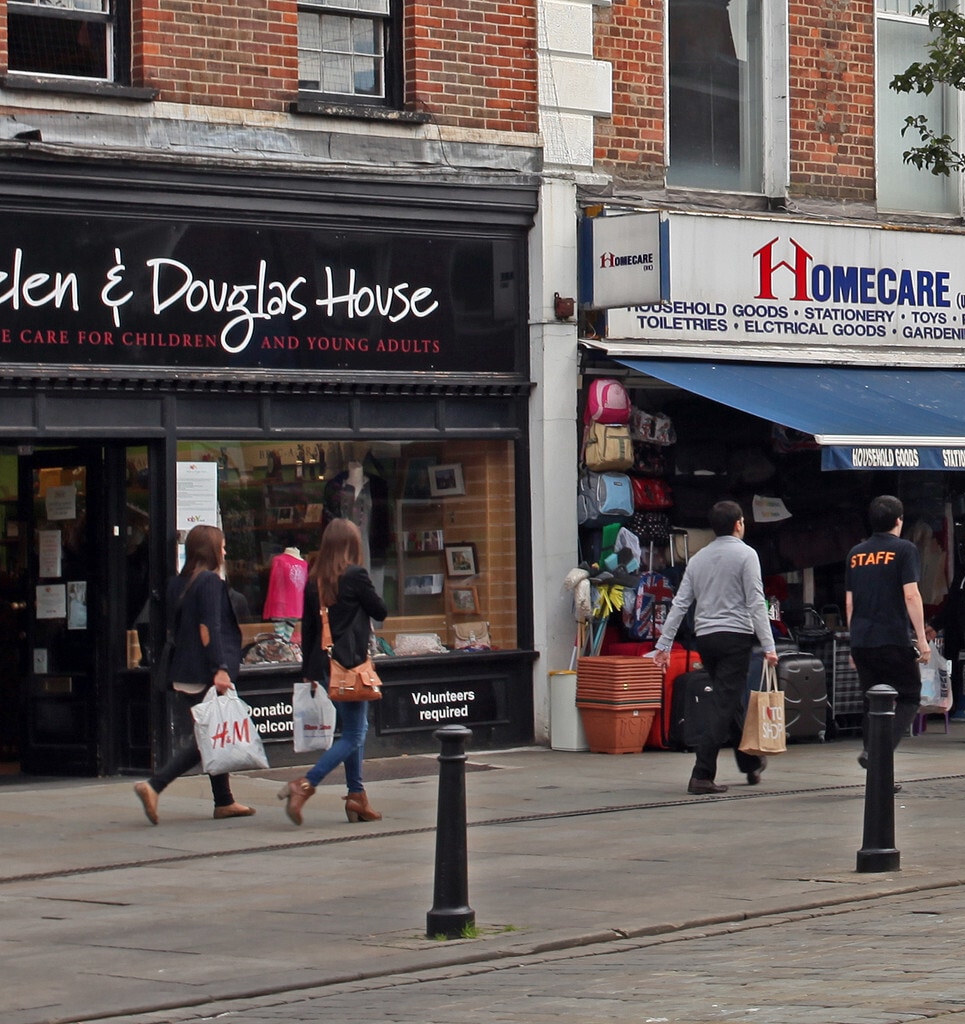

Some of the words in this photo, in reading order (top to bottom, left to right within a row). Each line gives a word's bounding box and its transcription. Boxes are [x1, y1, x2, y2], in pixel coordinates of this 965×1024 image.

[600, 252, 653, 268] HOMECARE
[753, 236, 951, 307] HOMECARE
[101, 248, 134, 328] &
[146, 257, 307, 354] Douglas
[315, 266, 439, 323] House
[732, 304, 788, 318] GOODS
[804, 307, 895, 322] STATIONERY
[912, 311, 947, 324] TOYS
[637, 315, 728, 331] TOILETRIES
[744, 320, 828, 335] ELCTRICAL
[832, 324, 887, 337] GOODS
[20, 329, 69, 345] CARE
[78, 331, 114, 345] FOR
[121, 332, 218, 347] CHILDREN
[260, 336, 299, 350] AND
[306, 336, 369, 352] YOUNG
[376, 339, 440, 353] ADULTS
[852, 448, 894, 467] HOUSEHOLD
[894, 448, 919, 467] GOODS
[851, 551, 896, 569] STAFF
[411, 690, 475, 705] Volunteers
[420, 704, 468, 722] required
[211, 718, 250, 749] H&M
[762, 723, 783, 740] SHOP
